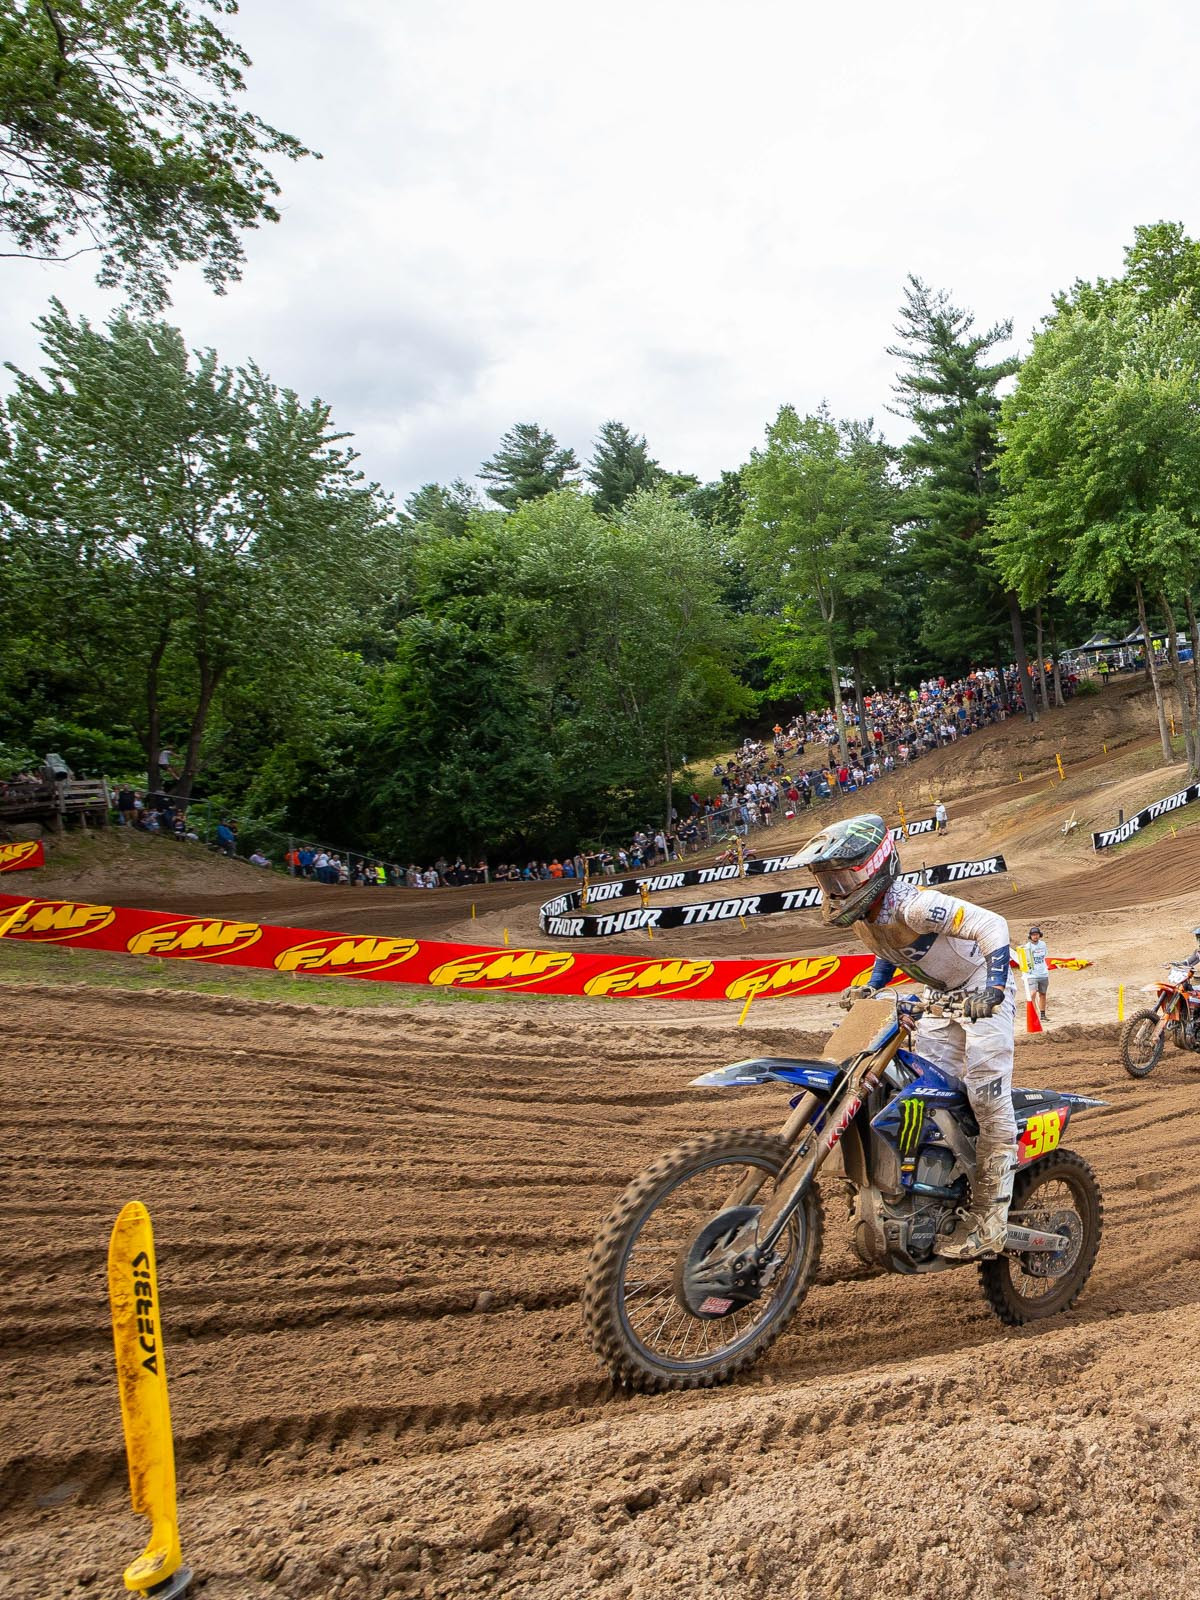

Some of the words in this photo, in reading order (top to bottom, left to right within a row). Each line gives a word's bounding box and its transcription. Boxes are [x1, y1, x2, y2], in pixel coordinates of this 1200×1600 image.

[1148, 792, 1188, 820] THOR
[1100, 817, 1140, 847] THOR
[635, 873, 685, 891] THOR
[948, 858, 1000, 880] THOR
[544, 896, 568, 915] THOR
[681, 896, 760, 924] THOR
[781, 887, 823, 909] TH
[547, 917, 585, 937] THOR
[596, 909, 661, 935] THOR
[130, 923, 259, 955] FMF
[277, 939, 416, 971] FMF
[431, 952, 573, 986] FMF
[587, 960, 712, 996] FMF
[727, 956, 838, 1000] FMF
[912, 1087, 938, 1096] YZ
[1024, 1111, 1061, 1159] 38
[131, 1250, 158, 1376] ACERBIS
